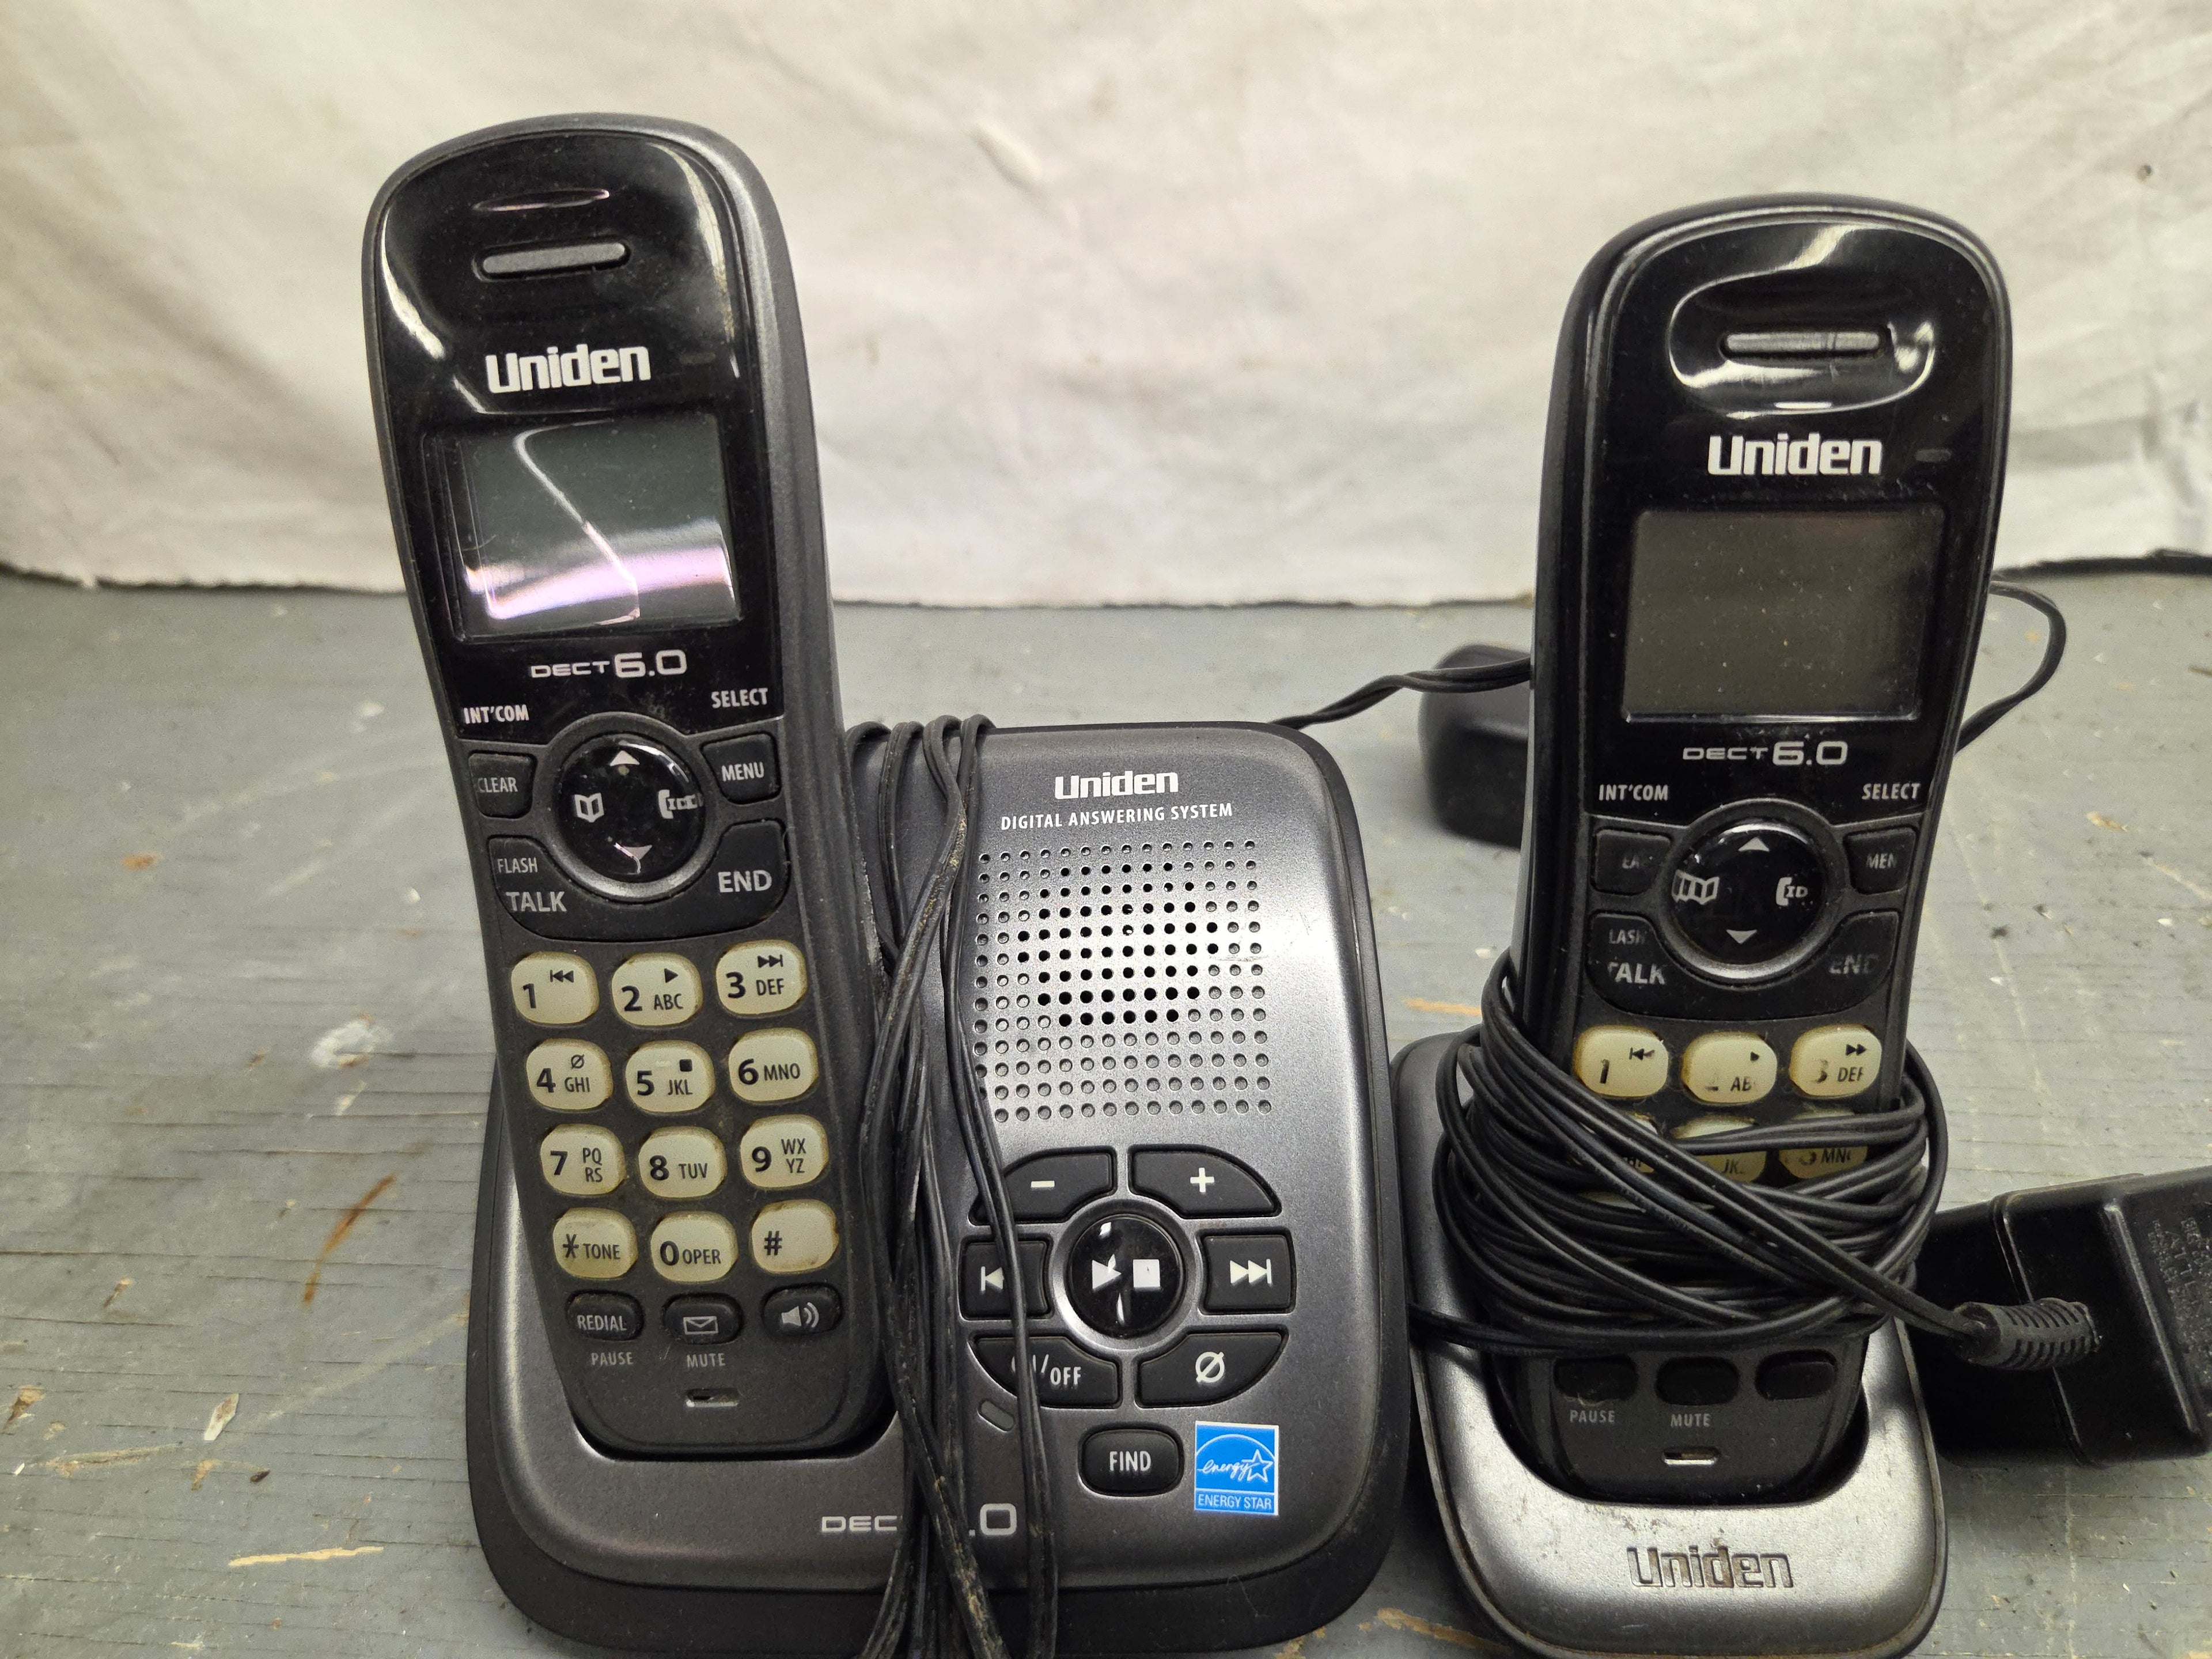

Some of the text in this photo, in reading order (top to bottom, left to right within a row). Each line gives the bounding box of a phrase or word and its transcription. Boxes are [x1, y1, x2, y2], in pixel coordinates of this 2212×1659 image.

[485, 344, 652, 394] Uniden
[1707, 433, 1882, 475] Uniden
[531, 649, 687, 679] DECT 6.0
[711, 688, 768, 709] SELECT
[463, 704, 529, 724] INT'COM
[1683, 741, 1848, 766] DECT 6.0
[721, 762, 764, 783] MENU
[477, 777, 518, 794] CLEAR
[1055, 771, 1179, 800] Uniden
[1599, 784, 1668, 801] INT'COM
[1862, 783, 1920, 800] SELECT
[1001, 803, 1233, 831] DIGITAL ANSWERING SYSTEM
[497, 858, 538, 874] FLASH
[1866, 853, 1897, 869] MEN
[718, 870, 772, 893] END
[506, 891, 567, 912] TALK
[1609, 929, 1646, 945] LASH
[725, 971, 785, 998] 3 DEF
[522, 983, 537, 1009] 1
[622, 986, 684, 1012] 2 ABC
[536, 1068, 590, 1093] 4 GHI
[738, 1059, 800, 1085] 6 MNO
[637, 1070, 693, 1096] 5 JKL
[550, 1147, 603, 1176] 7 PQ
[751, 1138, 806, 1172] 9 WX
[585, 1167, 603, 1183] RS
[649, 1155, 708, 1181] 8 TUV
[785, 1158, 805, 1174] YZ
[584, 1243, 621, 1260] TONE
[660, 1241, 721, 1266] 0 OPER
[764, 1230, 782, 1256] #
[577, 1315, 627, 1331] REDIAL
[591, 1351, 633, 1365] PAUSE
[687, 1353, 726, 1368] MUTE
[1569, 1410, 1615, 1423] PAUSE
[1671, 1414, 1711, 1427] MUTE
[1109, 1451, 1152, 1472] FIND
[1202, 1459, 1253, 1482] energy
[1198, 1494, 1272, 1510] ENERGY STAR
[821, 1515, 903, 1532] DEC
[1627, 1545, 1794, 1588] Uniden
